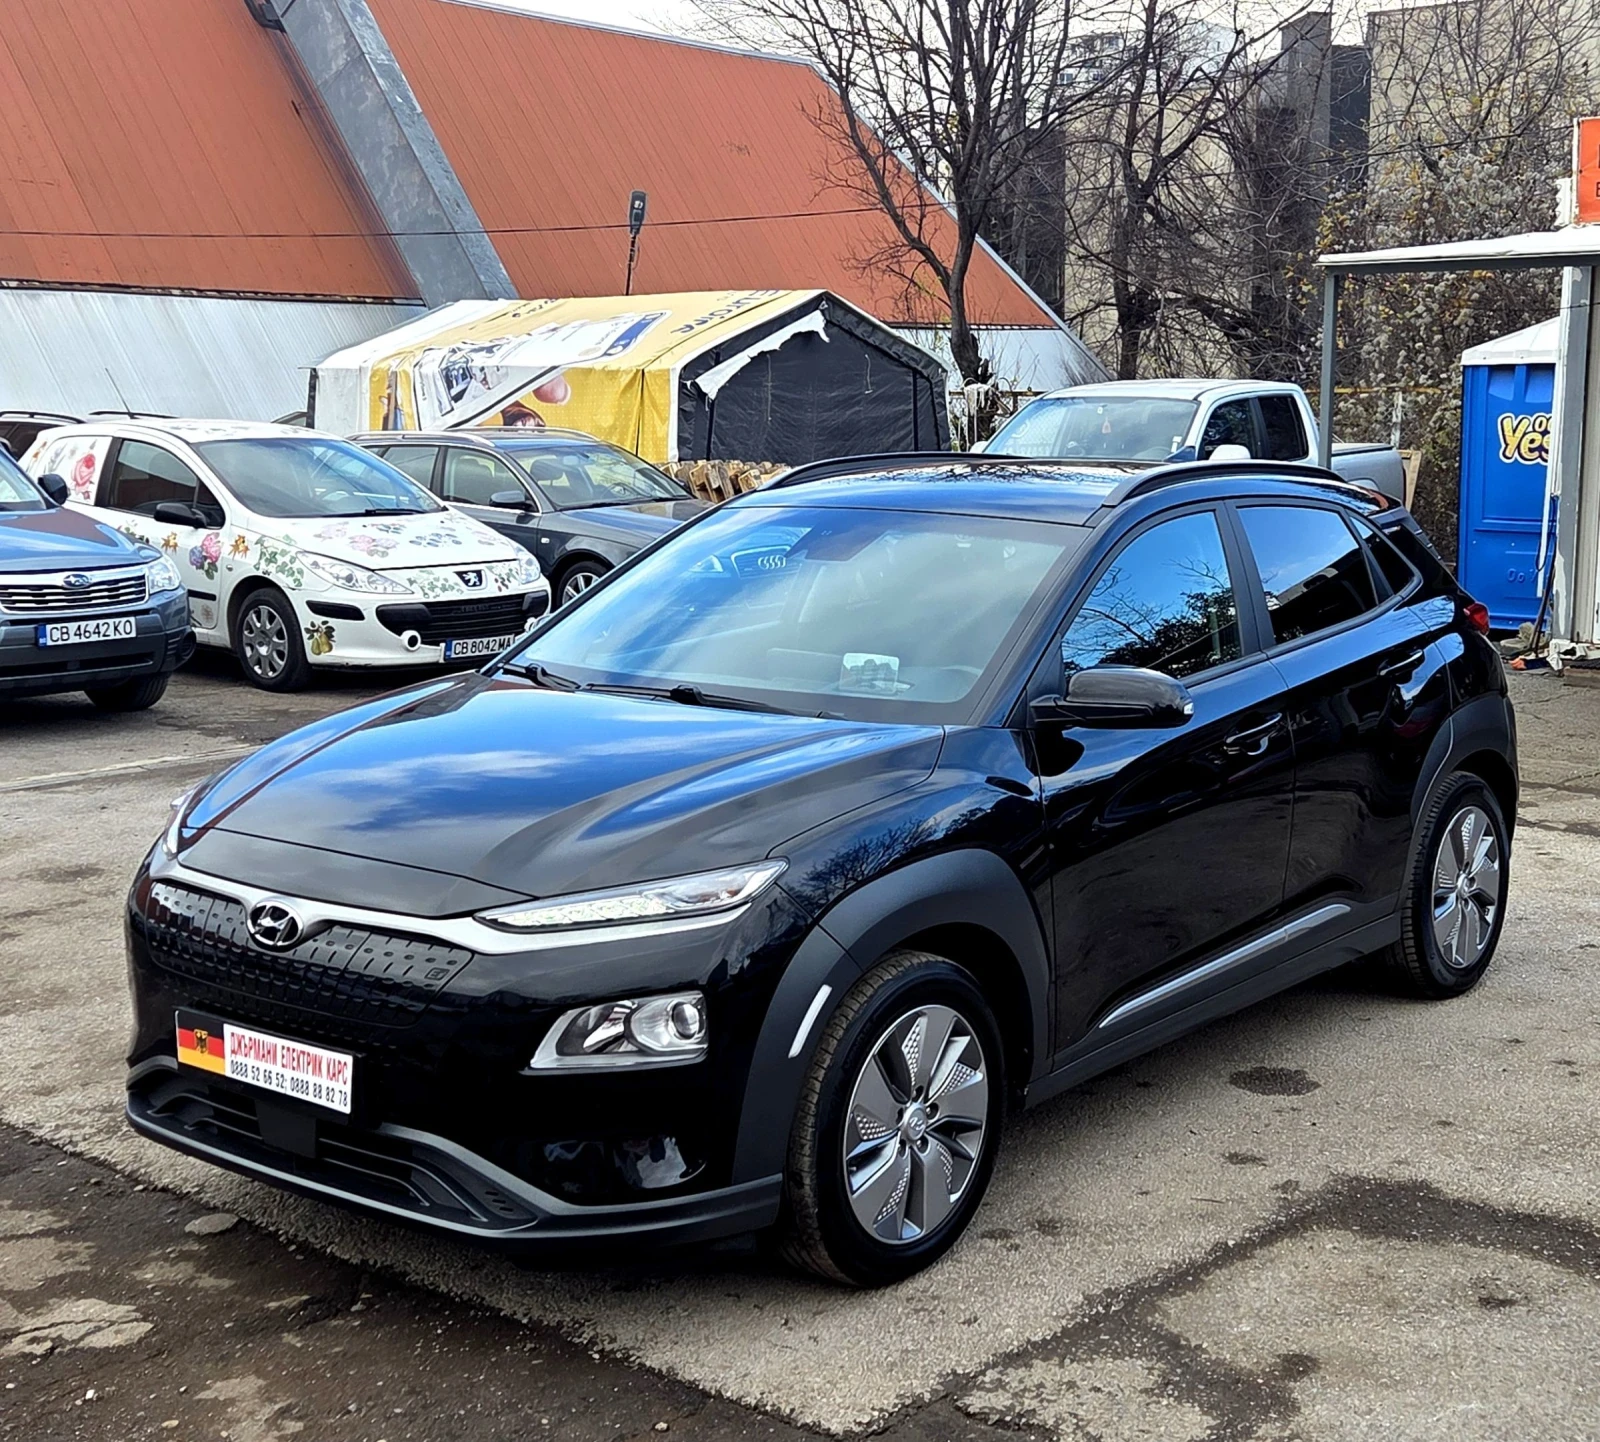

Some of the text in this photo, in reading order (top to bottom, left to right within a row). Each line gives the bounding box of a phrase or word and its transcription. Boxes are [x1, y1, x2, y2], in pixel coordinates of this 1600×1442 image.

[49, 626, 70, 642] CB
[73, 622, 111, 639] 4642
[113, 619, 133, 637] KO
[454, 642, 468, 655] CB
[470, 639, 497, 653] 8042
[230, 1032, 348, 1085] ДЖЪРМАНИ ЕЛЕКТРИК КАРС
[230, 1060, 248, 1078] 0888
[251, 1066, 260, 1082] 52
[290, 1076, 309, 1096] 0888
[313, 1083, 322, 1100] 88
[325, 1086, 335, 1103] 82
[338, 1090, 348, 1107] 78
